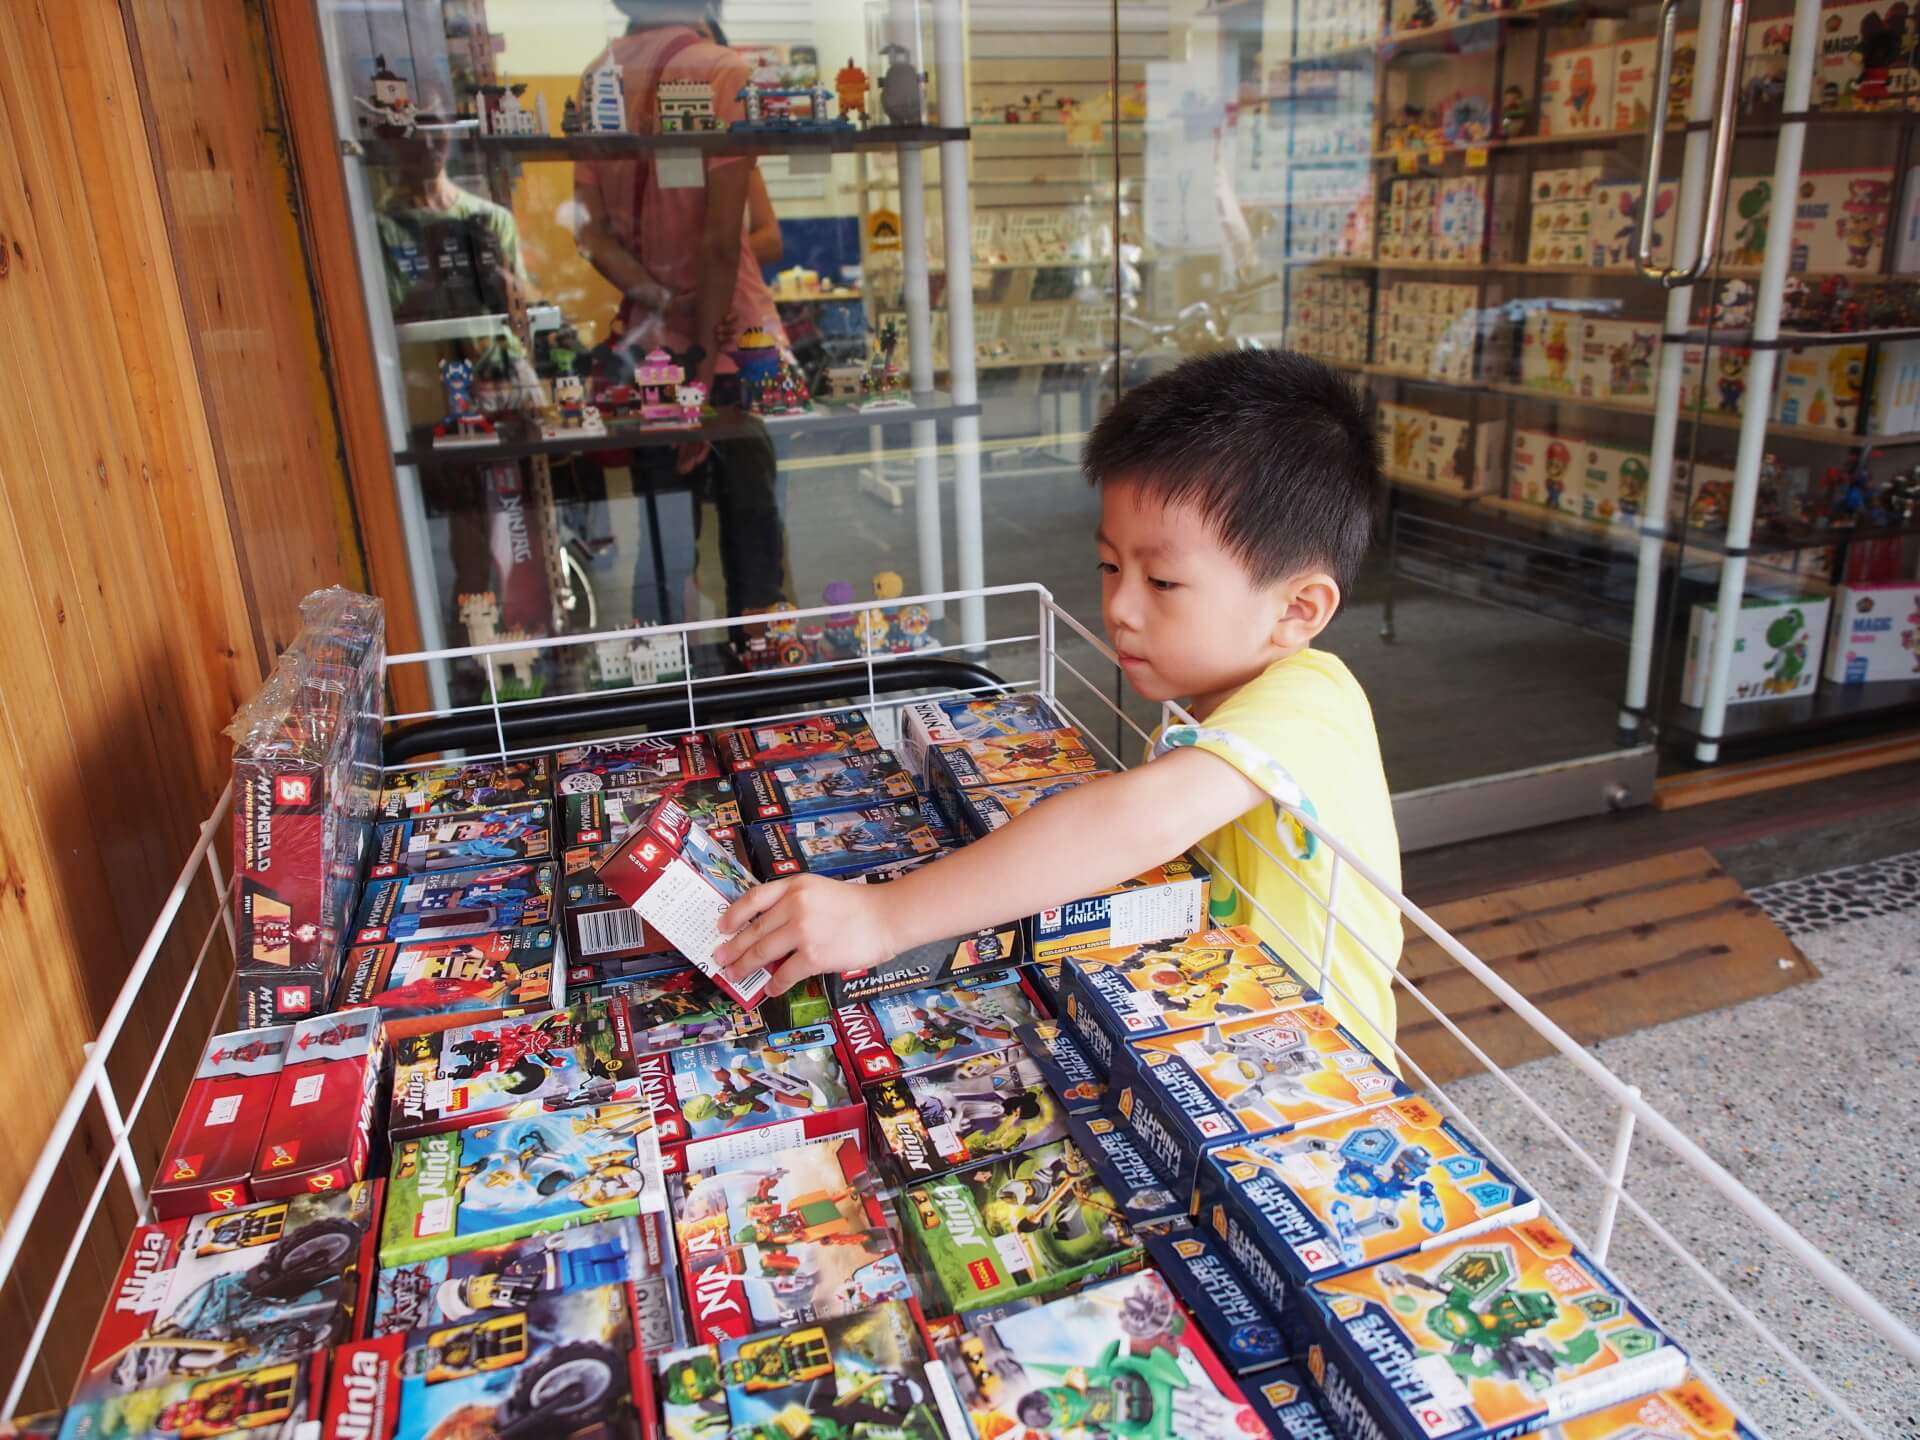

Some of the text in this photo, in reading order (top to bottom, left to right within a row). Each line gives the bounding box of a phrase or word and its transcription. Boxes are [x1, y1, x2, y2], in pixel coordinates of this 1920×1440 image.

[256, 776, 272, 872] MYWORLD
[366, 881, 393, 928] MYWORLD
[1065, 898, 1112, 916] FUTUR
[499, 933, 513, 952] 5-12
[347, 947, 376, 1003] MYWORLD
[843, 964, 930, 993] MYWORLD
[1088, 972, 1130, 1015] FUTURE
[681, 1049, 698, 1070] 5-12
[404, 1070, 425, 1121] Ninja
[1152, 1065, 1203, 1119] FUTURE
[417, 1139, 450, 1198] Ninja
[895, 1121, 934, 1173] Ninja
[1097, 1134, 1145, 1190] FUTURE
[934, 1184, 987, 1249] Ninja
[1241, 1180, 1305, 1246] FUTURE
[115, 1232, 166, 1316] Ninja
[1186, 1258, 1249, 1326] FUTURE
[1344, 1318, 1423, 1402] FUTURE
